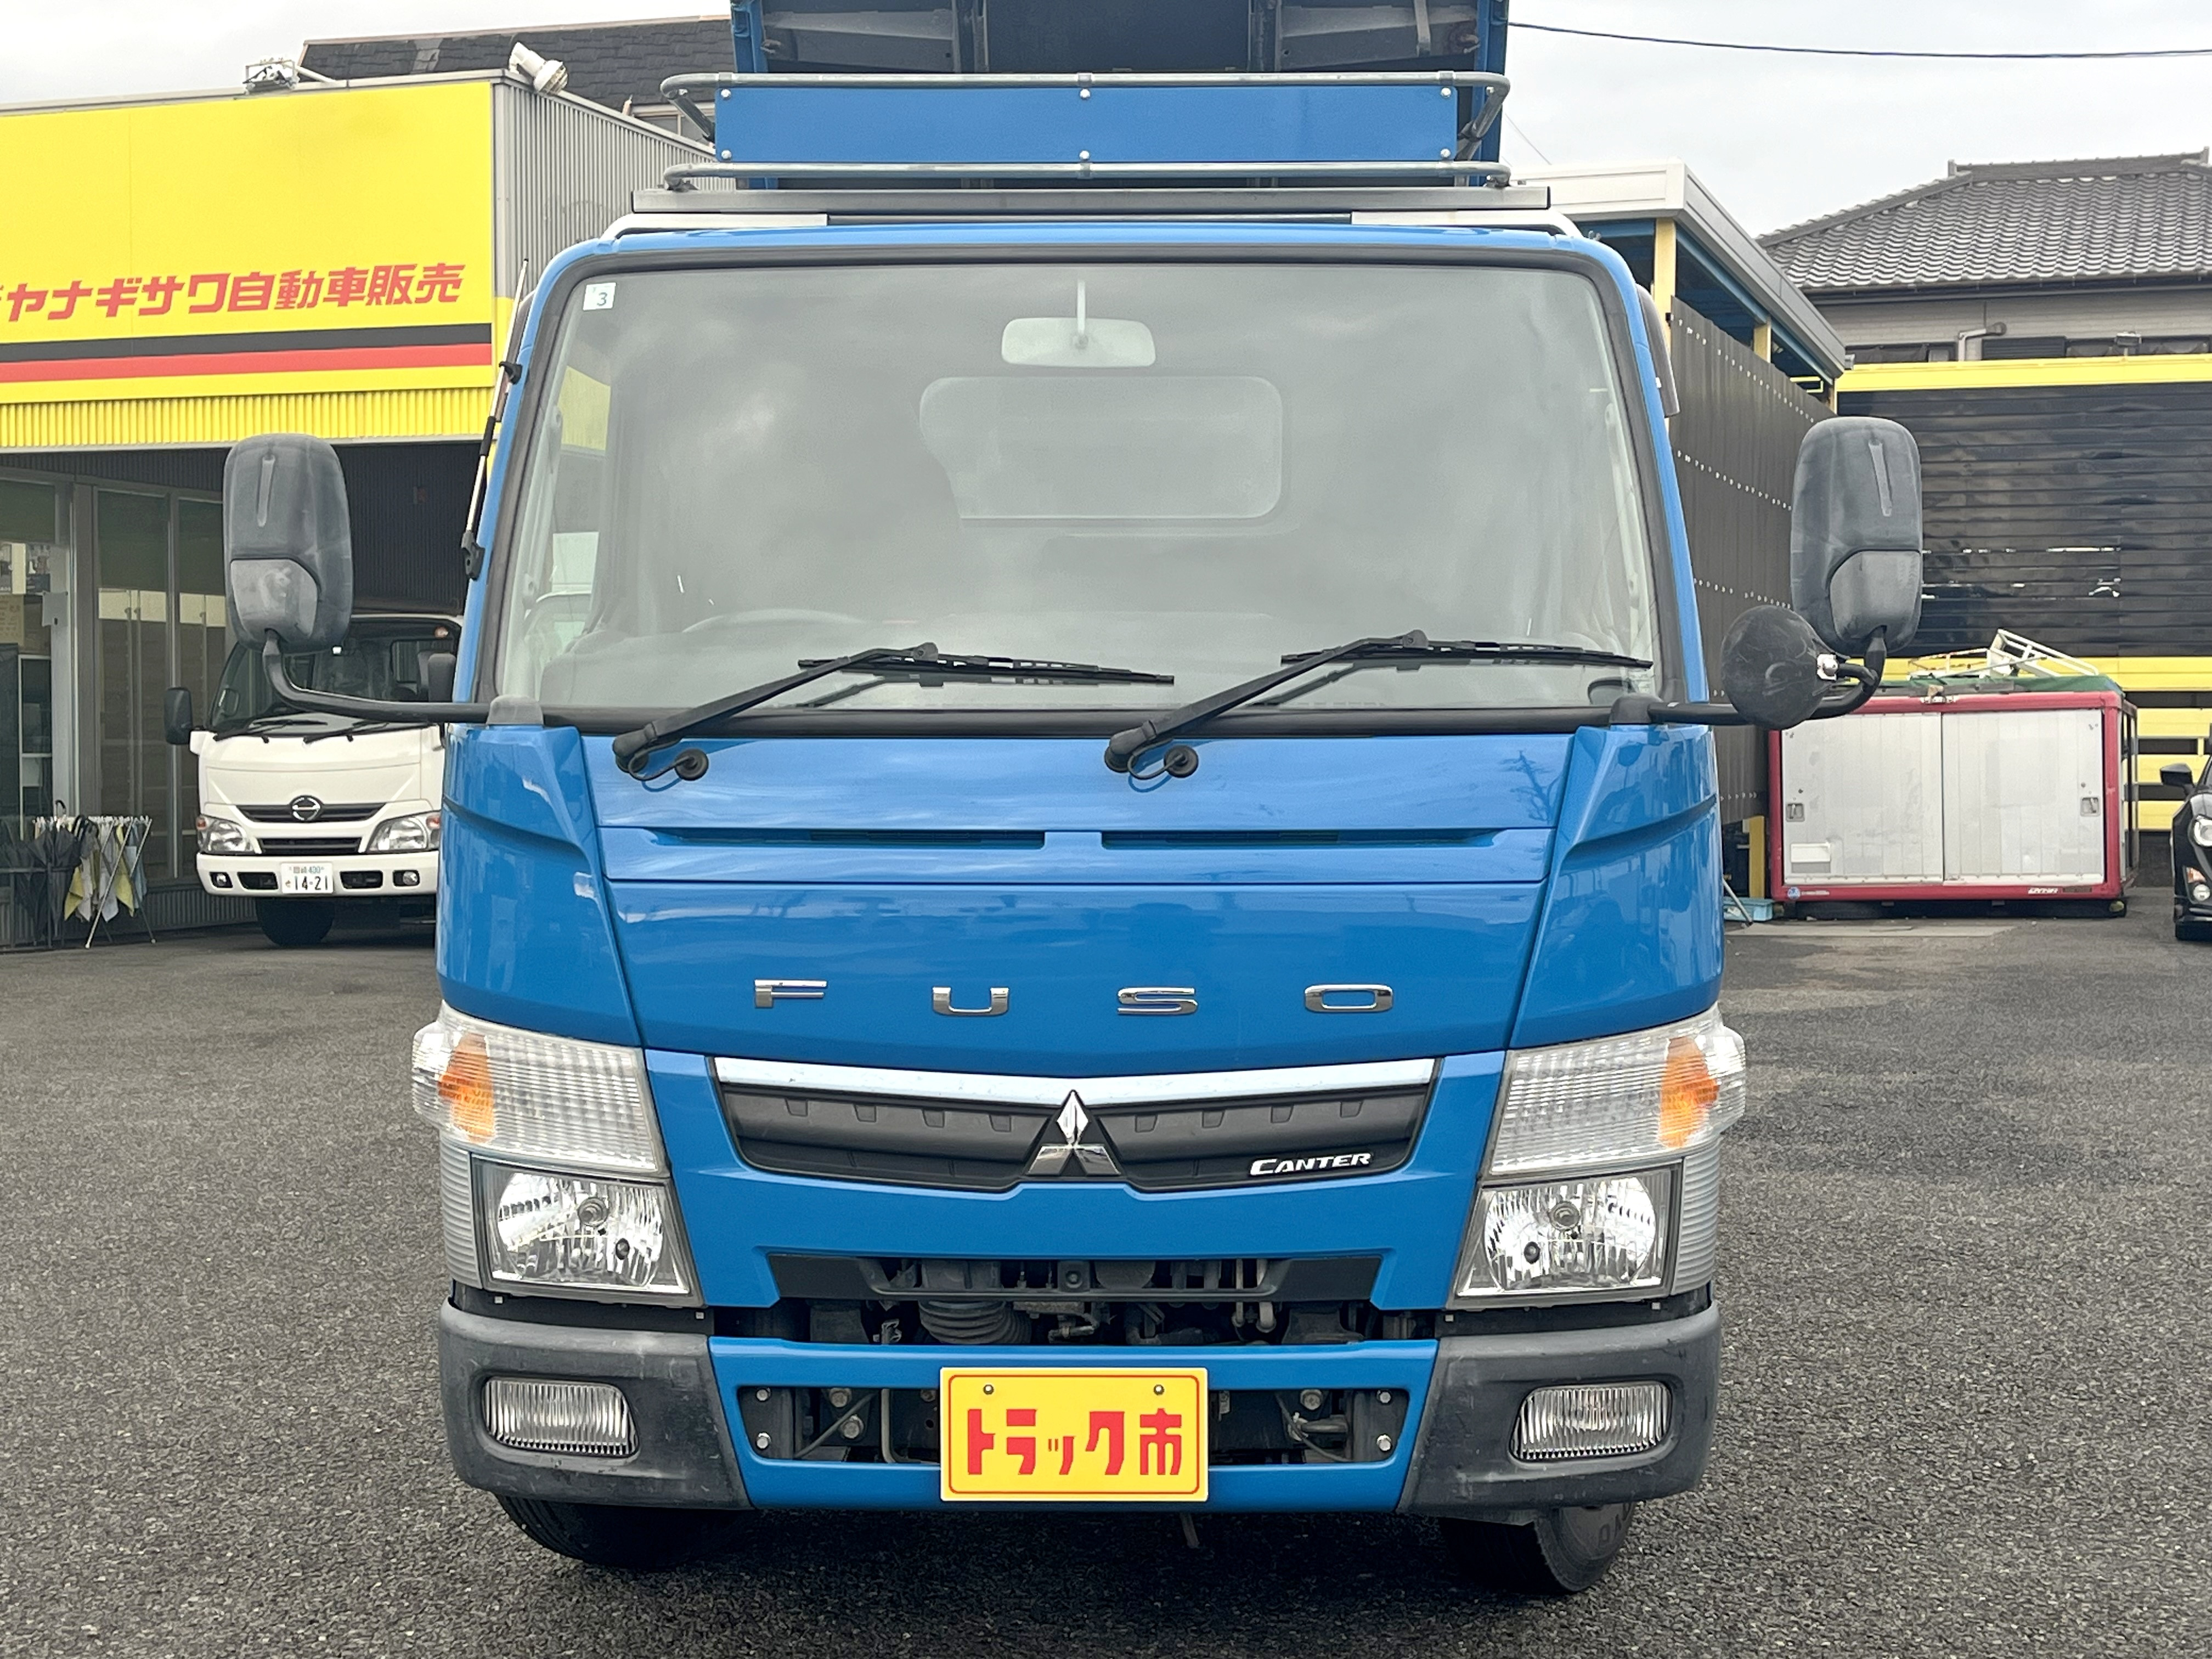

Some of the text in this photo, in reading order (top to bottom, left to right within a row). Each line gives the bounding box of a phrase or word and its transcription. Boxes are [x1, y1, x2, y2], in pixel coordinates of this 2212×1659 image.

[0, 262, 466, 322] ヤナギサワ自動車販売
[596, 292, 608, 306] 3
[755, 979, 1393, 1015] FUSO
[967, 1408, 1182, 1475] トラック市
